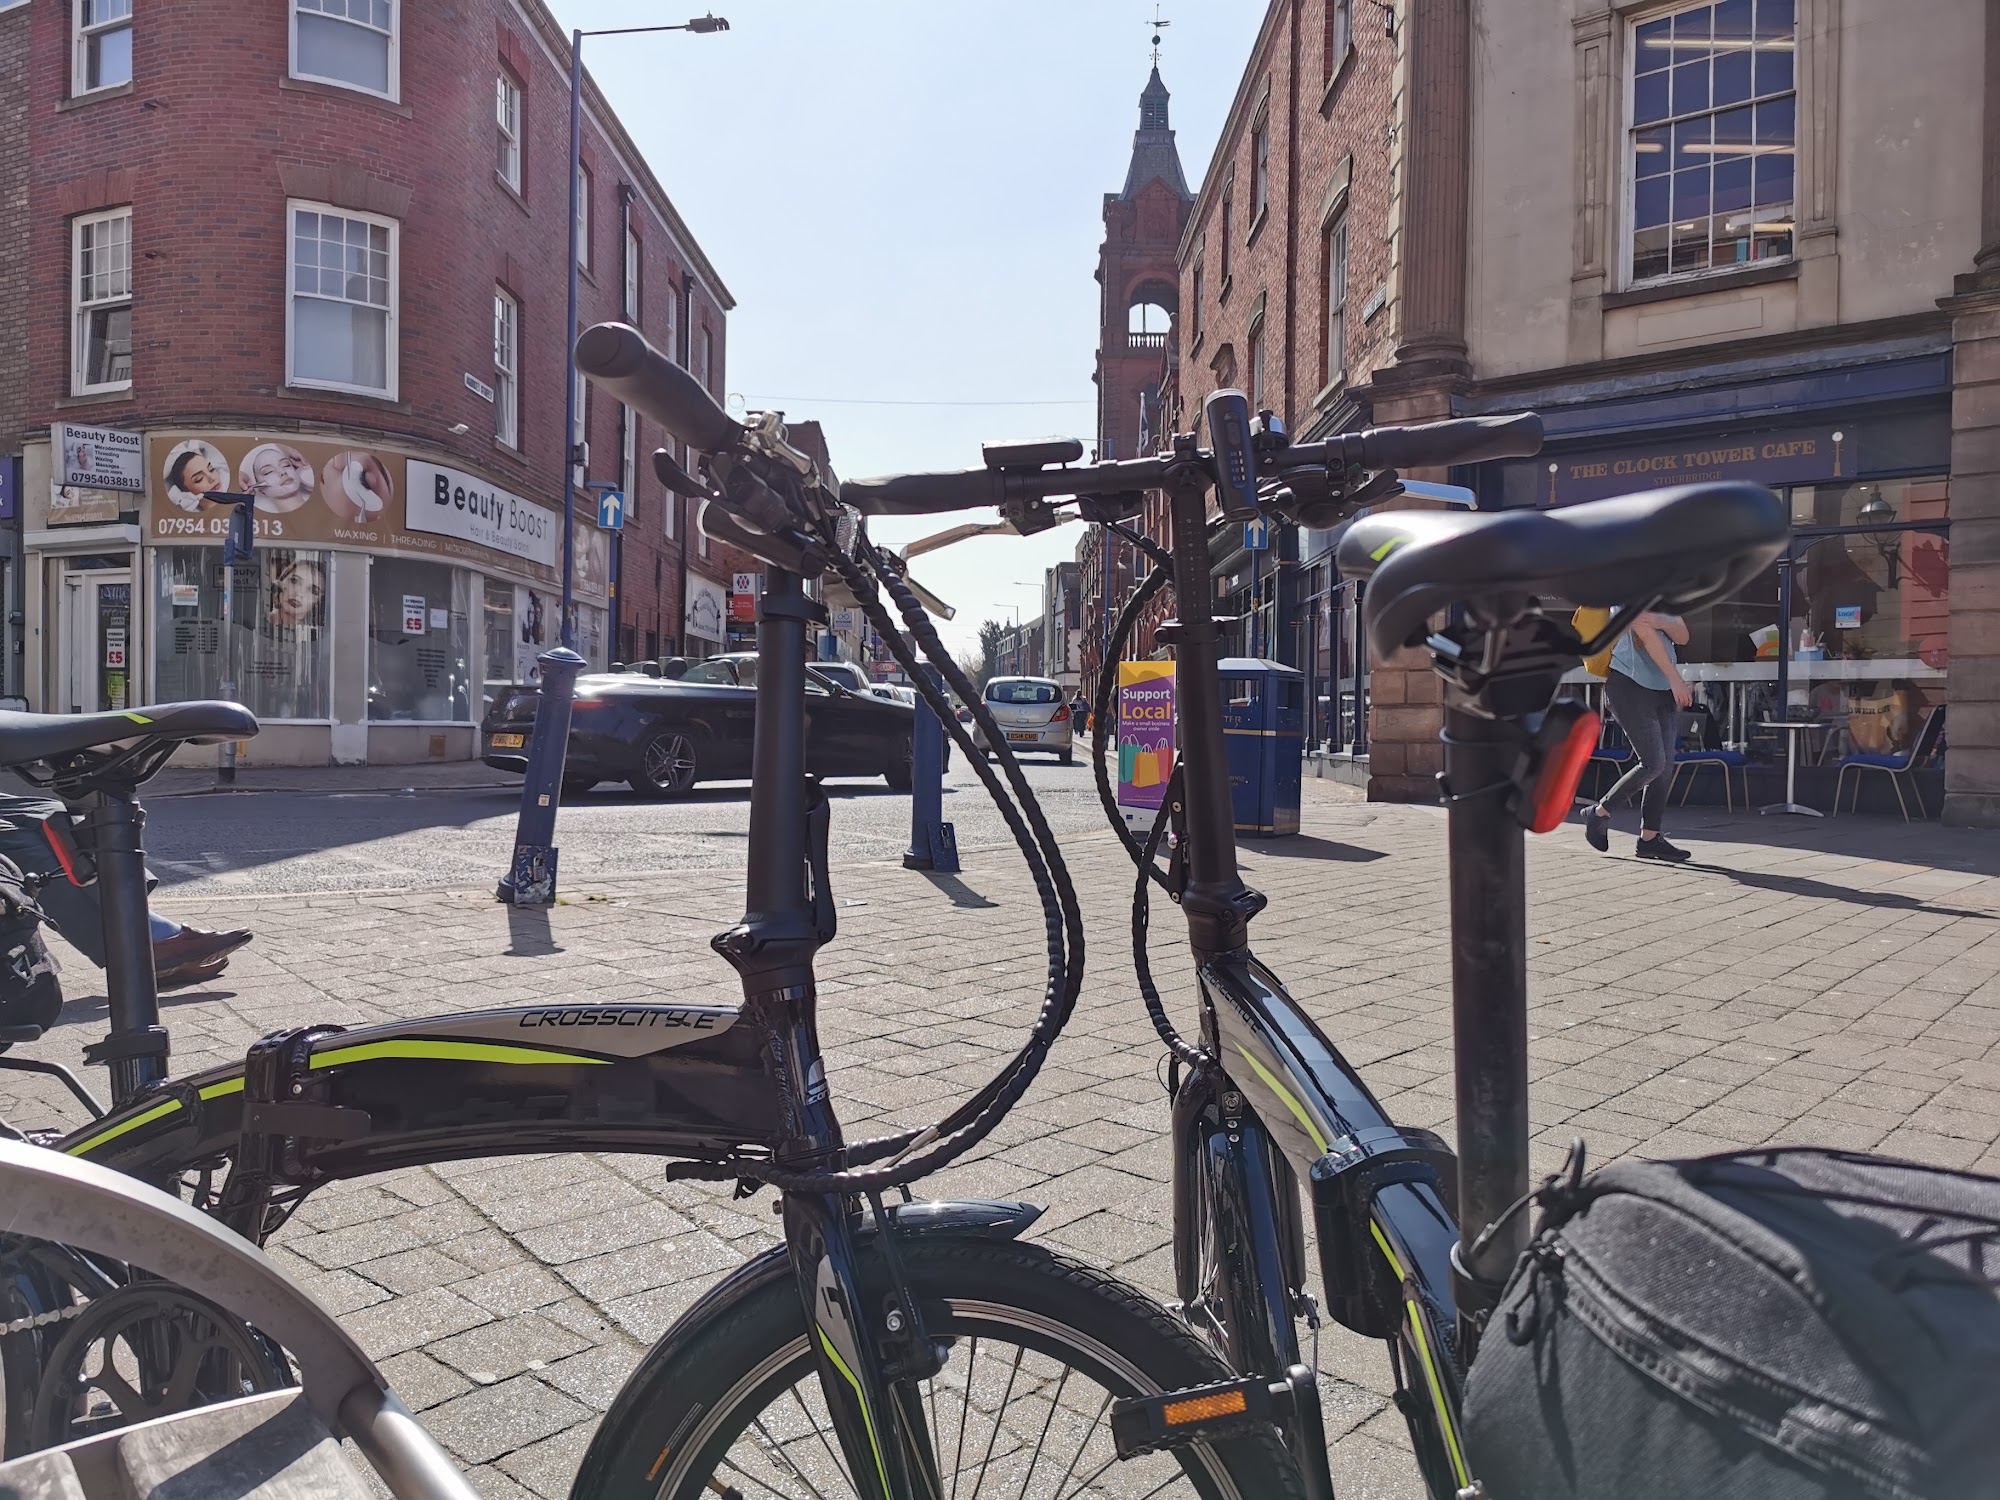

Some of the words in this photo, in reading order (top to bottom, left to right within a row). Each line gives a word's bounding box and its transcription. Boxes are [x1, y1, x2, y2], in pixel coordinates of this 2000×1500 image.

[66, 427, 106, 443] Beauty
[109, 432, 140, 446] Boost
[1570, 463, 1607, 479] THE
[1613, 455, 1678, 475] CLOCK
[1683, 447, 1756, 468] TOWER
[1762, 439, 1816, 459] CAFE
[71, 472, 140, 488] 07954038813
[1653, 471, 1722, 486] STOURBRIDGE
[434, 473, 504, 531] Beauty
[509, 499, 548, 541] Boost
[158, 518, 205, 535] 07954
[334, 528, 378, 542] WAXING
[391, 534, 437, 549] THREADING
[491, 530, 512, 550] Beauty
[218, 567, 256, 577] Bauty
[406, 617, 422, 631] £5
[108, 651, 123, 664] £5
[1122, 688, 1171, 702] Support
[1122, 701, 1171, 720] Local
